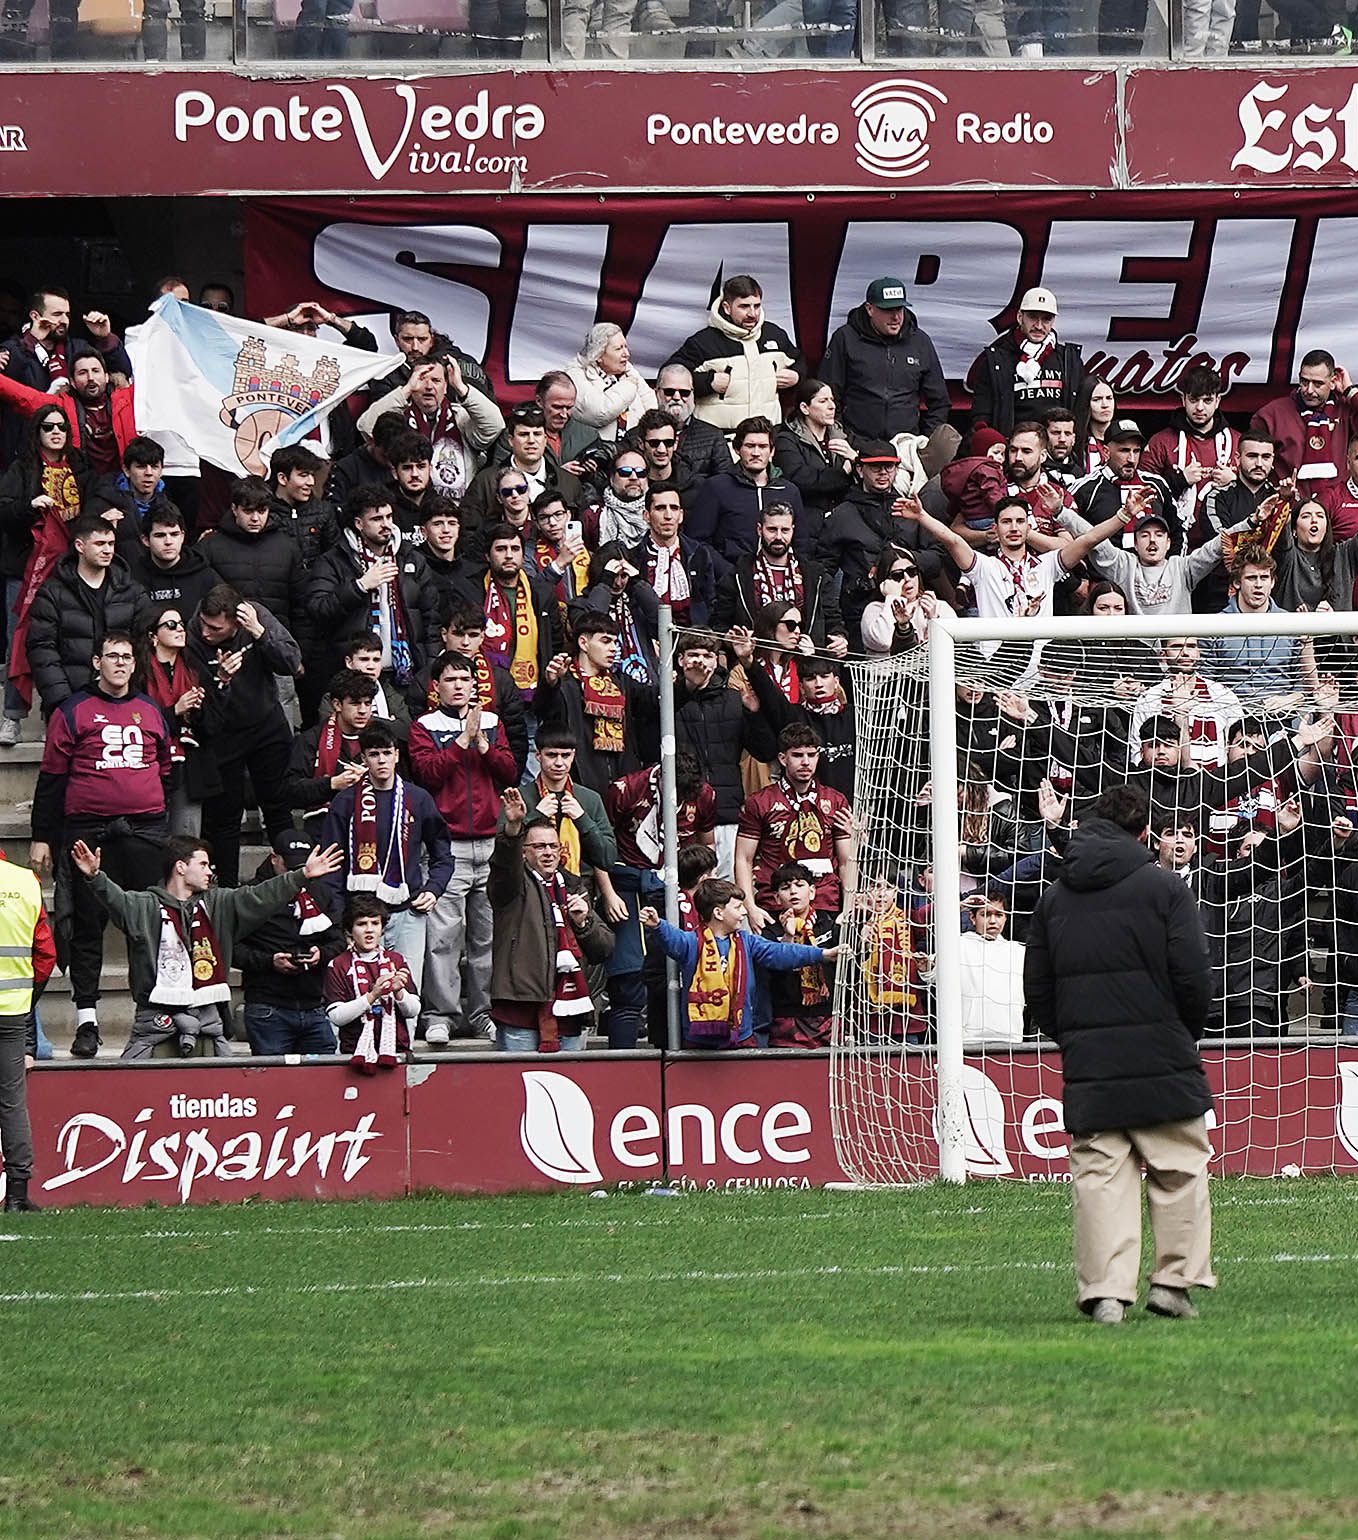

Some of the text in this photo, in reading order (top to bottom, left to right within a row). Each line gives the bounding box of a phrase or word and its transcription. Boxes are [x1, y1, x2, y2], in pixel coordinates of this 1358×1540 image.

[647, 112, 1054, 145] Pontevedra Viva Radio
[1014, 371, 1062, 381] TMY
[236, 393, 311, 415] PONTEVE
[1020, 388, 1061, 400] JEANS
[170, 1094, 258, 1119] tiendas
[610, 1101, 813, 1168] ence
[42, 1105, 383, 1203] Dispaint
